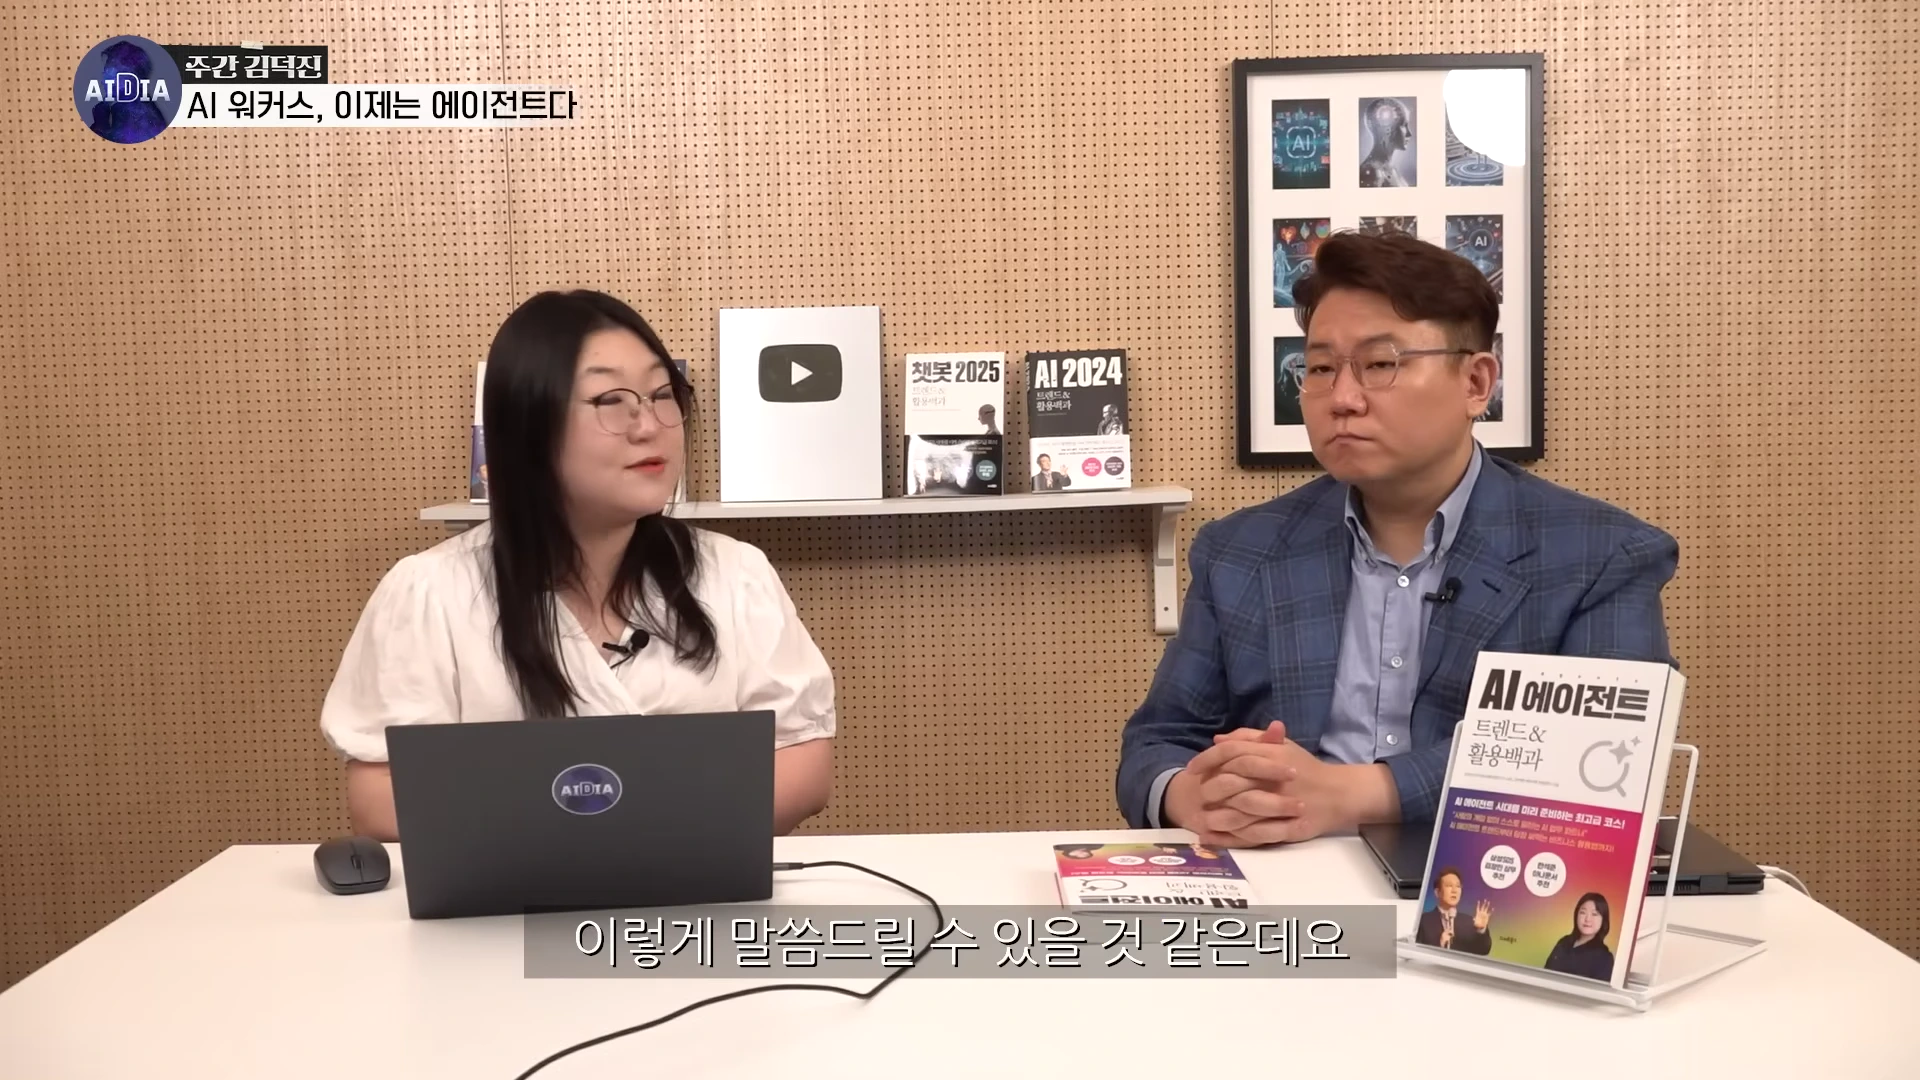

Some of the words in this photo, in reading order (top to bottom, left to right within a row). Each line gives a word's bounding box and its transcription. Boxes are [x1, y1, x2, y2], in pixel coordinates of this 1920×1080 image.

[1292, 134, 1310, 151] AI
[1474, 235, 1488, 247] AI
[912, 361, 952, 383] 챗봇
[955, 360, 1000, 382] 2025
[1034, 359, 1058, 389] AI
[1062, 356, 1123, 387] 2024
[1478, 668, 1522, 711] AI
[1521, 680, 1650, 722] 에이전트
[1468, 742, 1543, 772] 활용백과
[561, 781, 614, 796] AIDIA
[1454, 796, 1463, 806] AI
[1463, 797, 1494, 810] 에이전트
[1495, 802, 1520, 814] 시대를
[1521, 805, 1539, 816] 미리
[1540, 807, 1573, 821] 준비하는
[1575, 812, 1602, 825] 최고급
[1603, 817, 1625, 829] 코스!
